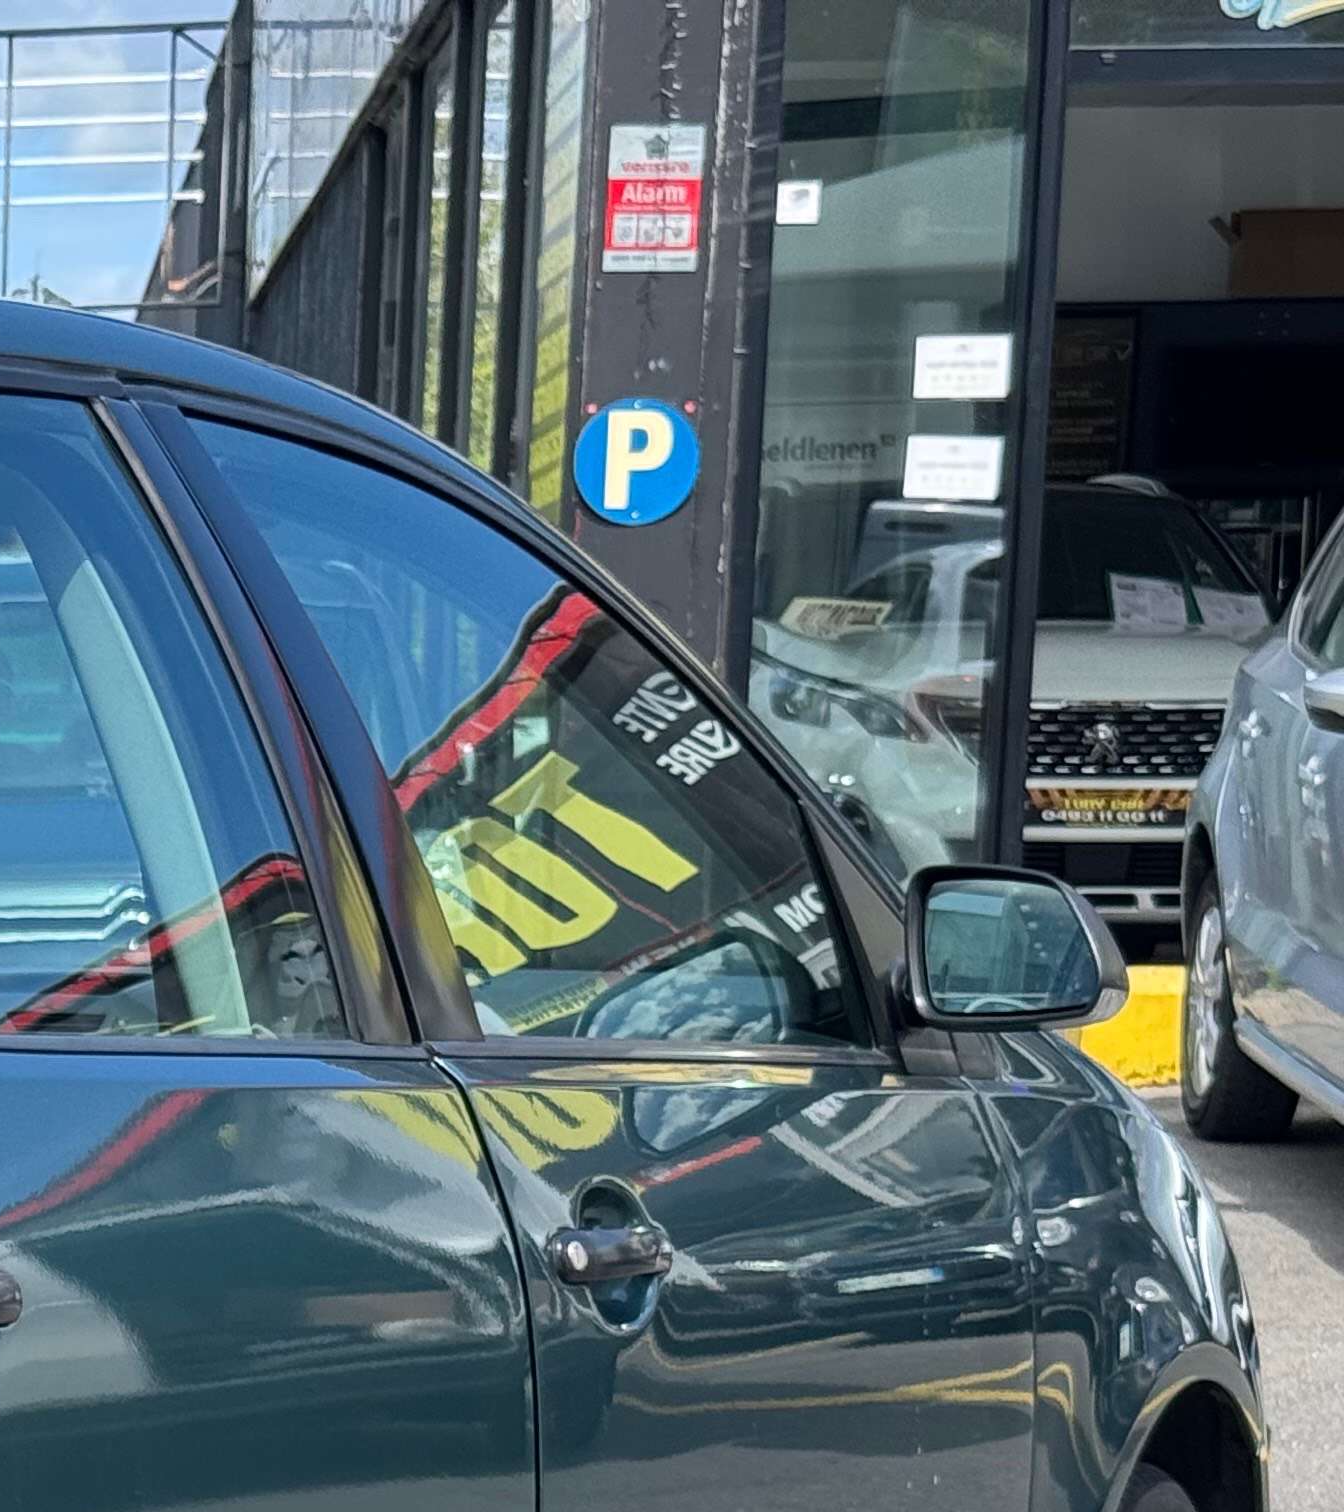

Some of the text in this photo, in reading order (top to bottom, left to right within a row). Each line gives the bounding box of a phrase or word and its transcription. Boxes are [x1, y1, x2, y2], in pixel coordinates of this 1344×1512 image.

[621, 181, 688, 204] Alarm
[603, 409, 674, 510] P
[762, 436, 877, 462] eldlenen
